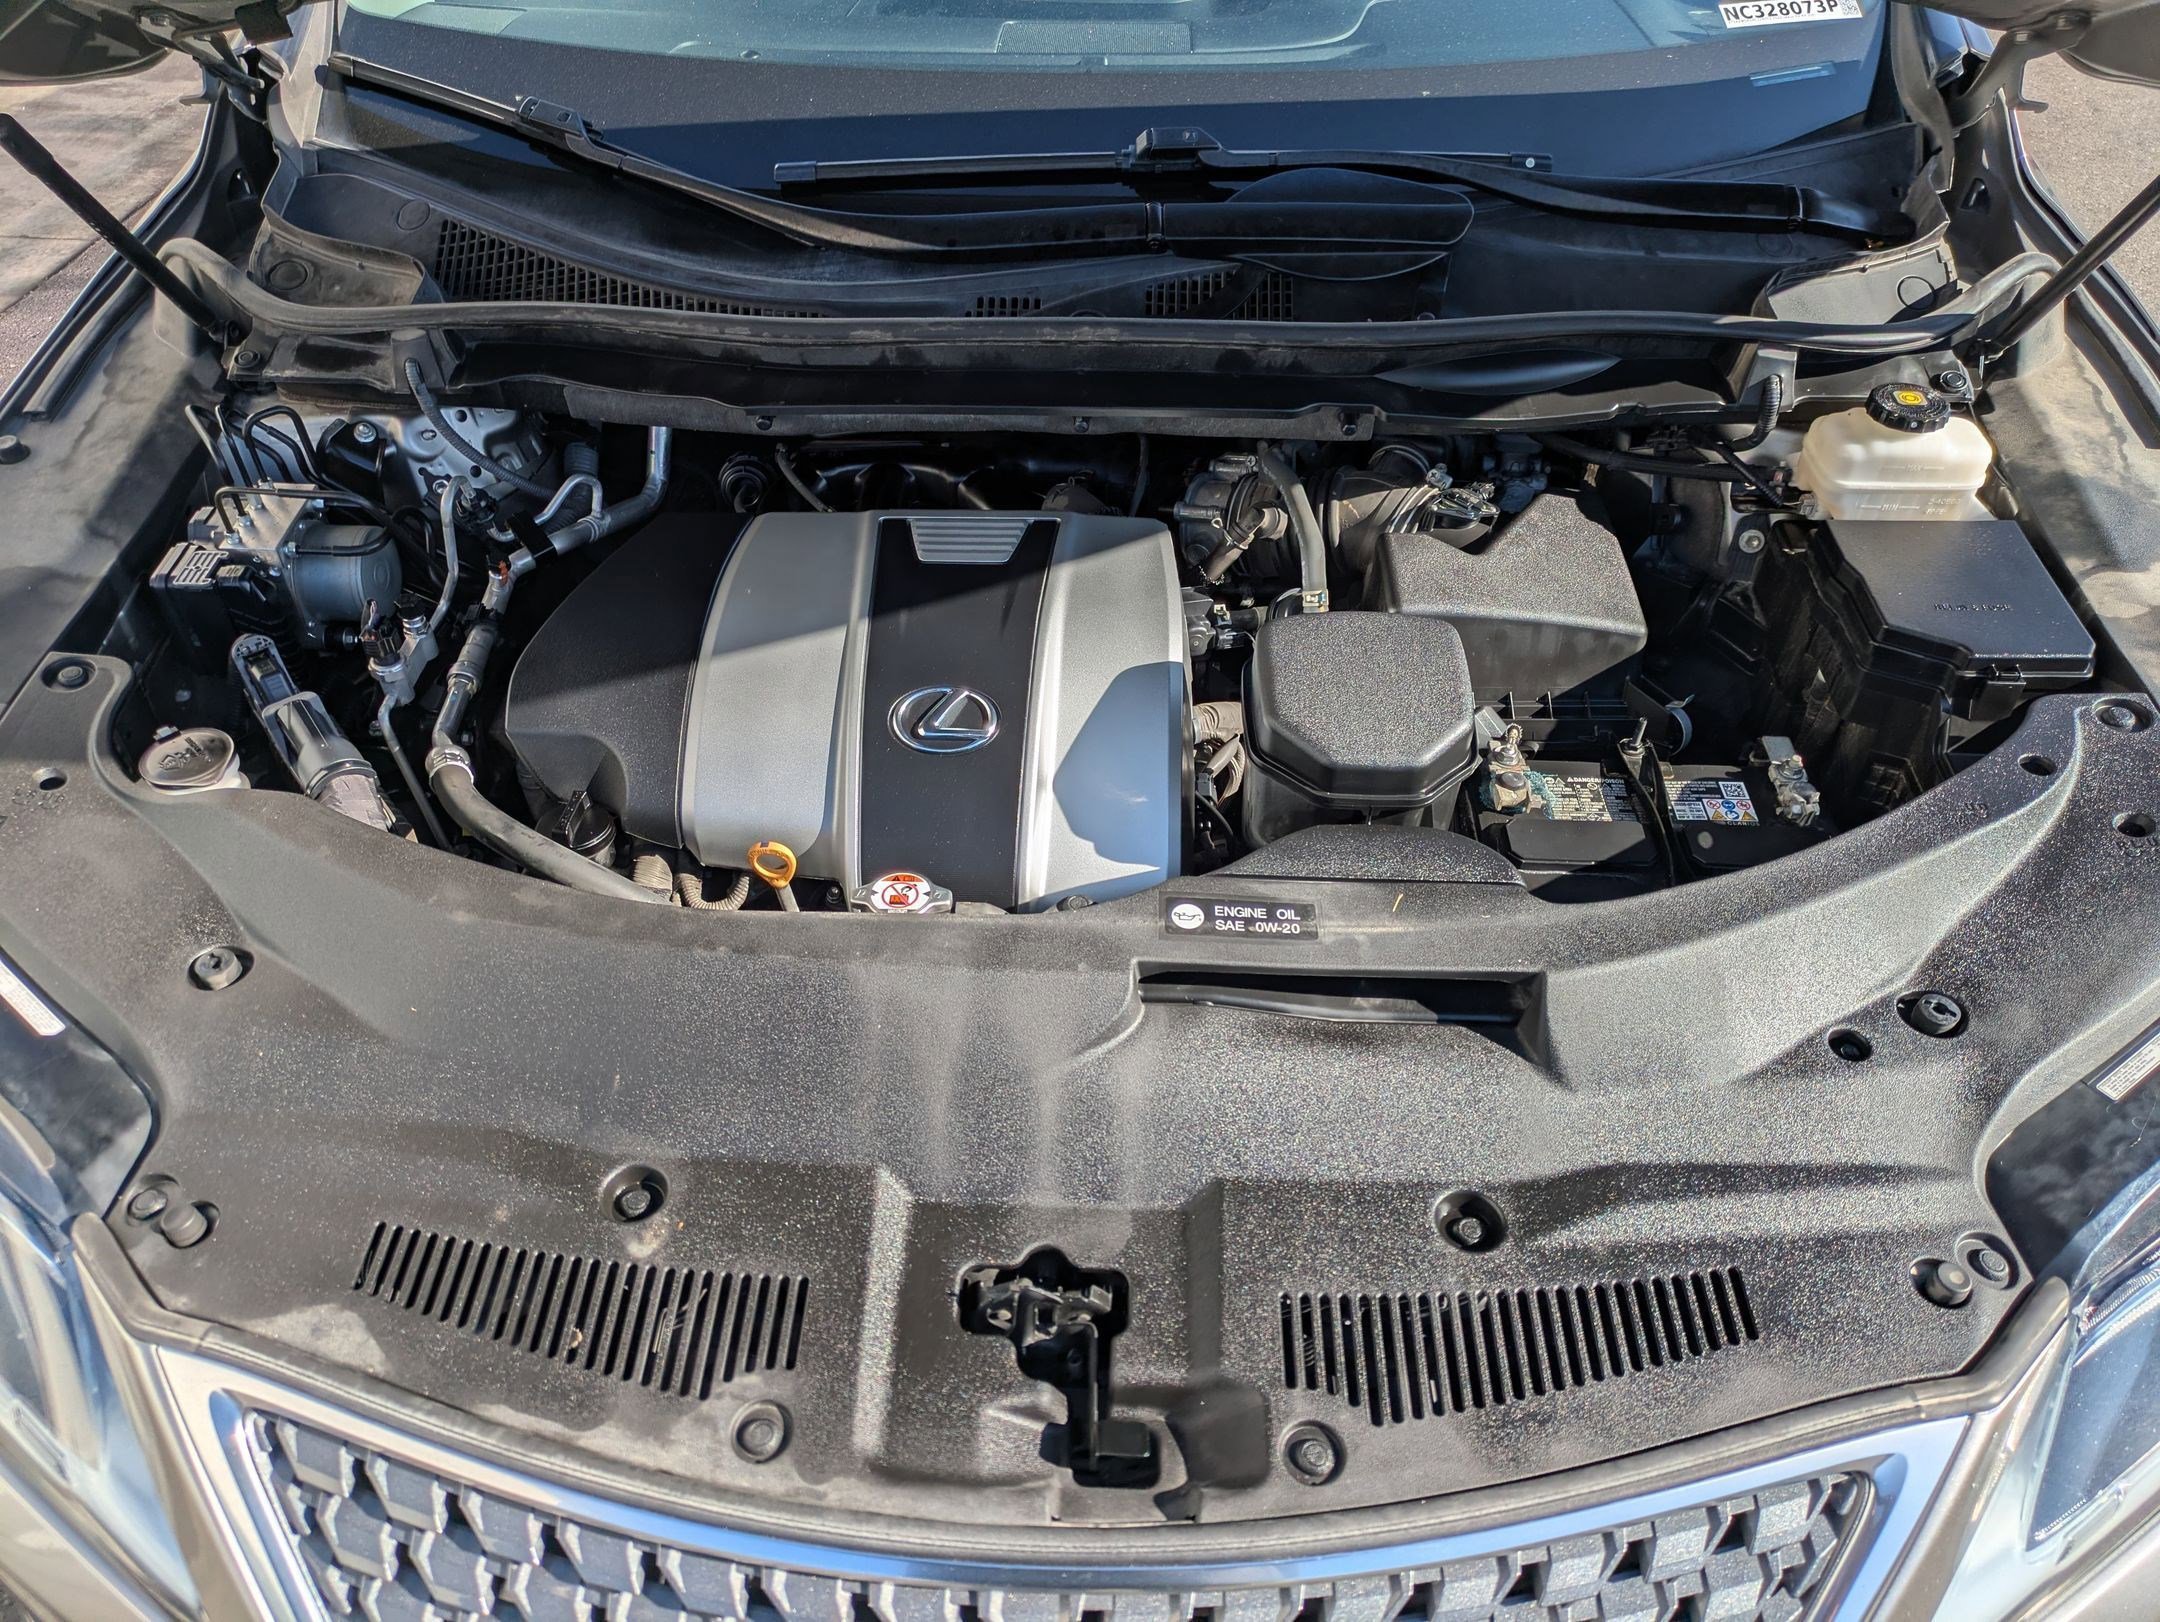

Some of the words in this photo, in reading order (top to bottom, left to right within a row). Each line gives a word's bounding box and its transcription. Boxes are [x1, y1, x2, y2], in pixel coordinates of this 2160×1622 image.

[1723, 0, 1838, 20] NC328073P
[1214, 905, 1267, 919] ENGINE
[1276, 908, 1301, 921] OIL
[1214, 919, 1246, 932] SAE
[1255, 922, 1301, 935] 0W-20
